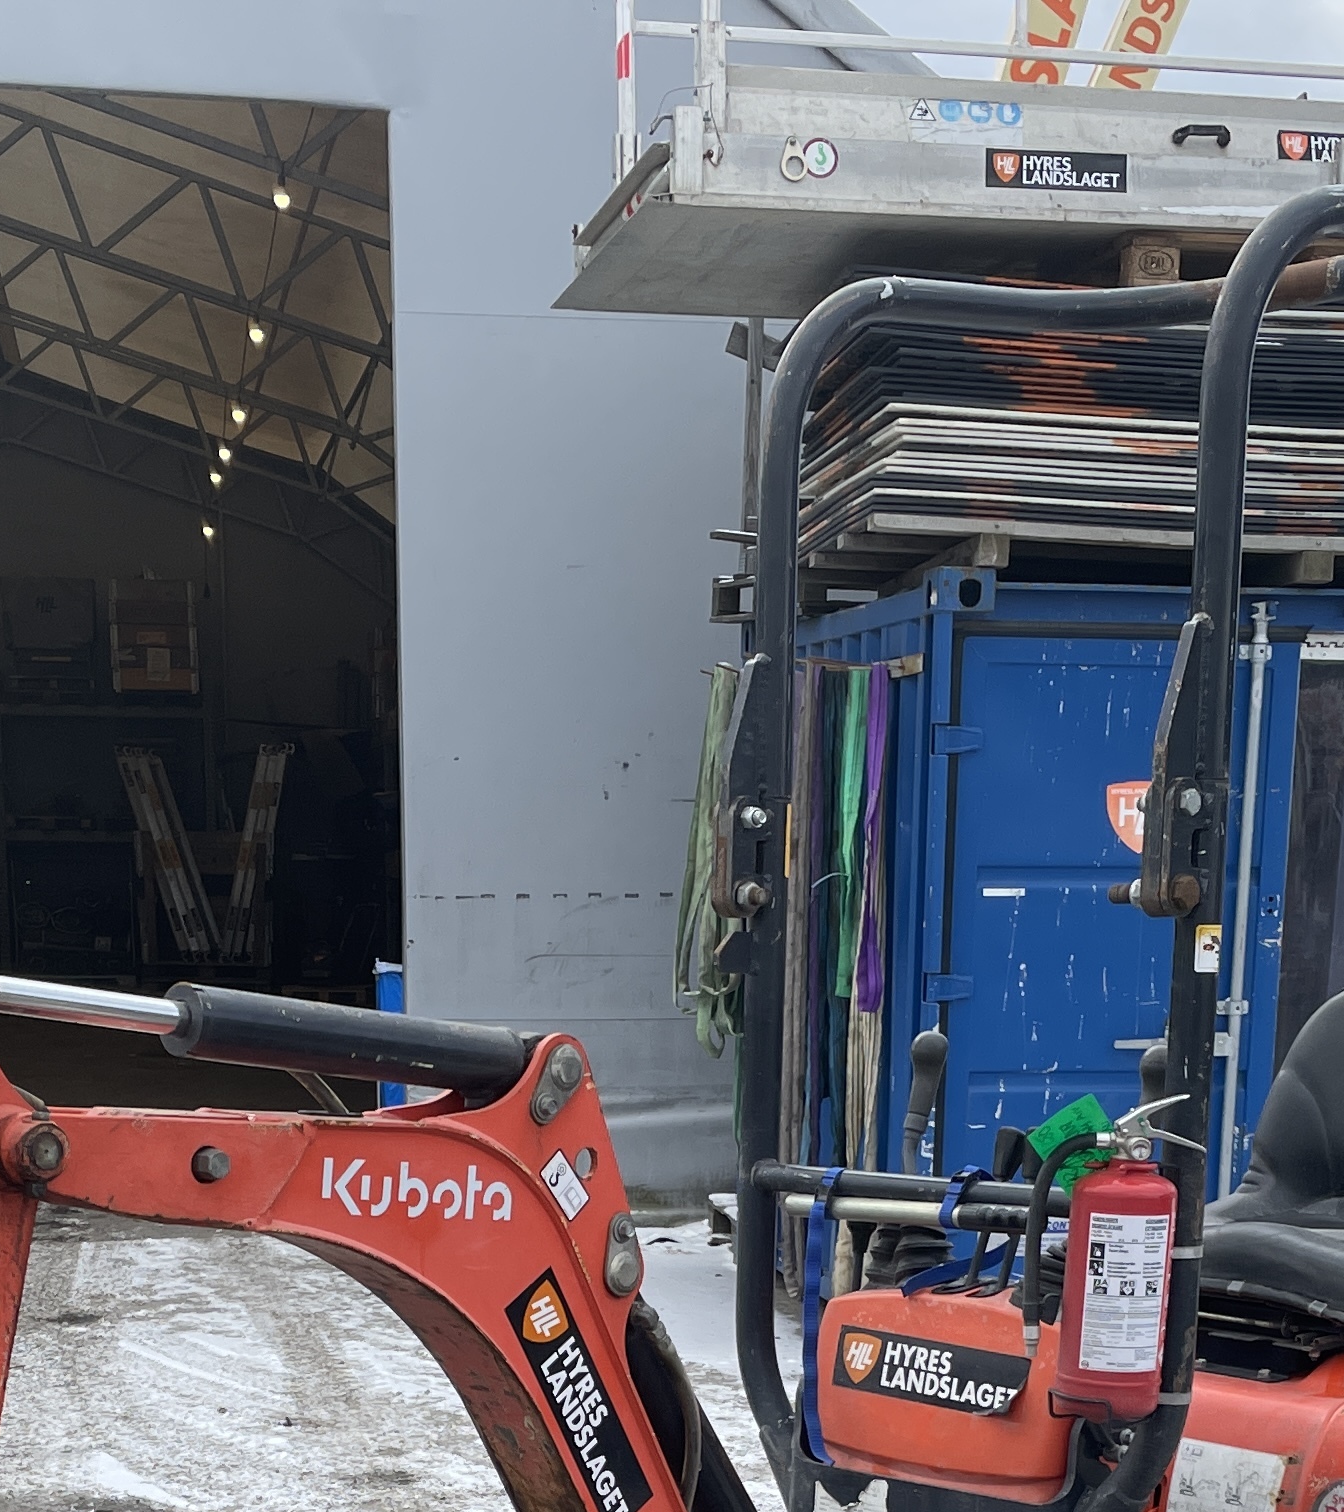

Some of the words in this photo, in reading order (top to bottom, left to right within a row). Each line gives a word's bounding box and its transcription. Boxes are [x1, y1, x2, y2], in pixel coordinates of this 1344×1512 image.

[1022, 155, 1072, 172] HYRES
[1022, 171, 1120, 188] LANDSLAGET
[321, 1156, 512, 1221] Kubota
[883, 1341, 953, 1375] HYRES
[557, 1335, 609, 1427] HYRES
